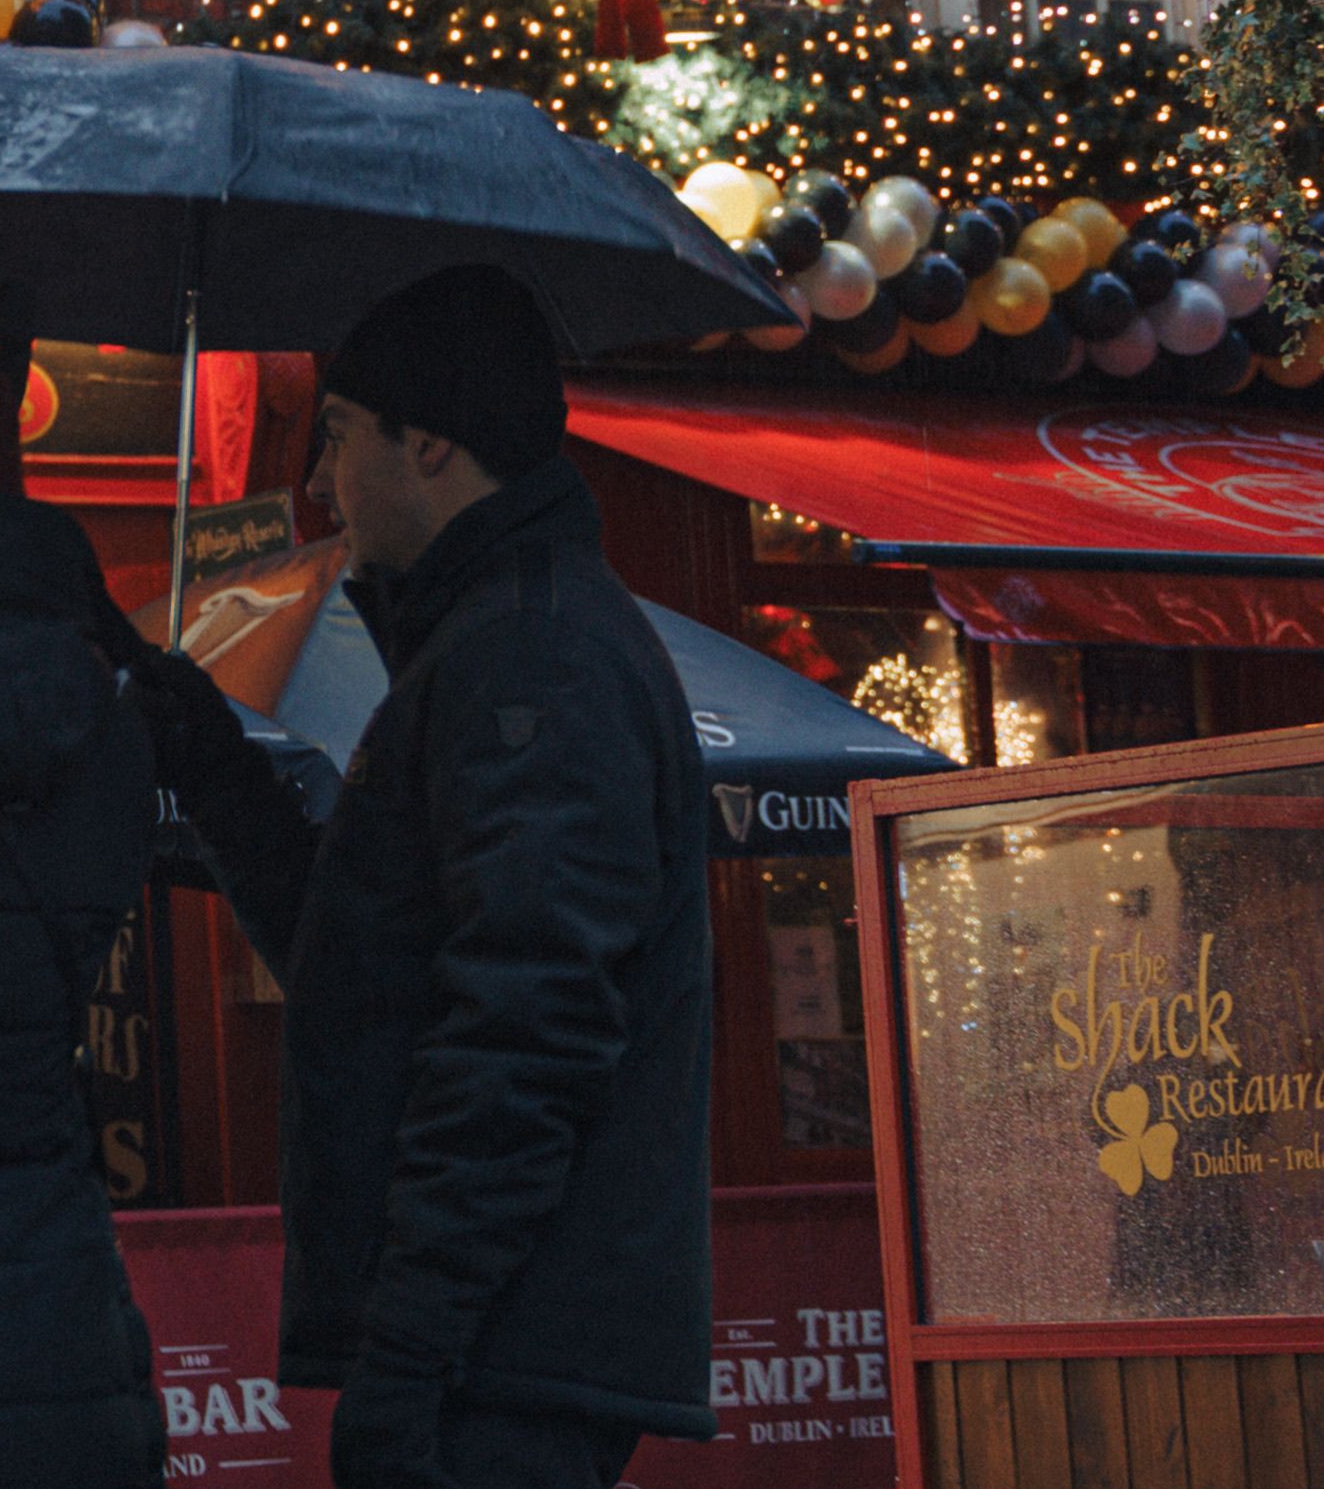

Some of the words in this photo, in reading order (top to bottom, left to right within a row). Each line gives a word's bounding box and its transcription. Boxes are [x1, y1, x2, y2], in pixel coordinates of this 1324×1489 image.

[758, 790, 852, 833] GUIN
[1110, 930, 1169, 994] The
[1052, 933, 1242, 1073] Shack
[1157, 1069, 1324, 1124] Restaur
[1192, 1136, 1264, 1179] Dublin
[1285, 1131, 1324, 1172] Irel
[796, 1308, 885, 1348] THE
[161, 1376, 293, 1438] BAR
[710, 1352, 888, 1408] EMPLE
[751, 1419, 832, 1444] DUBLIN
[850, 1415, 896, 1439] IREL
